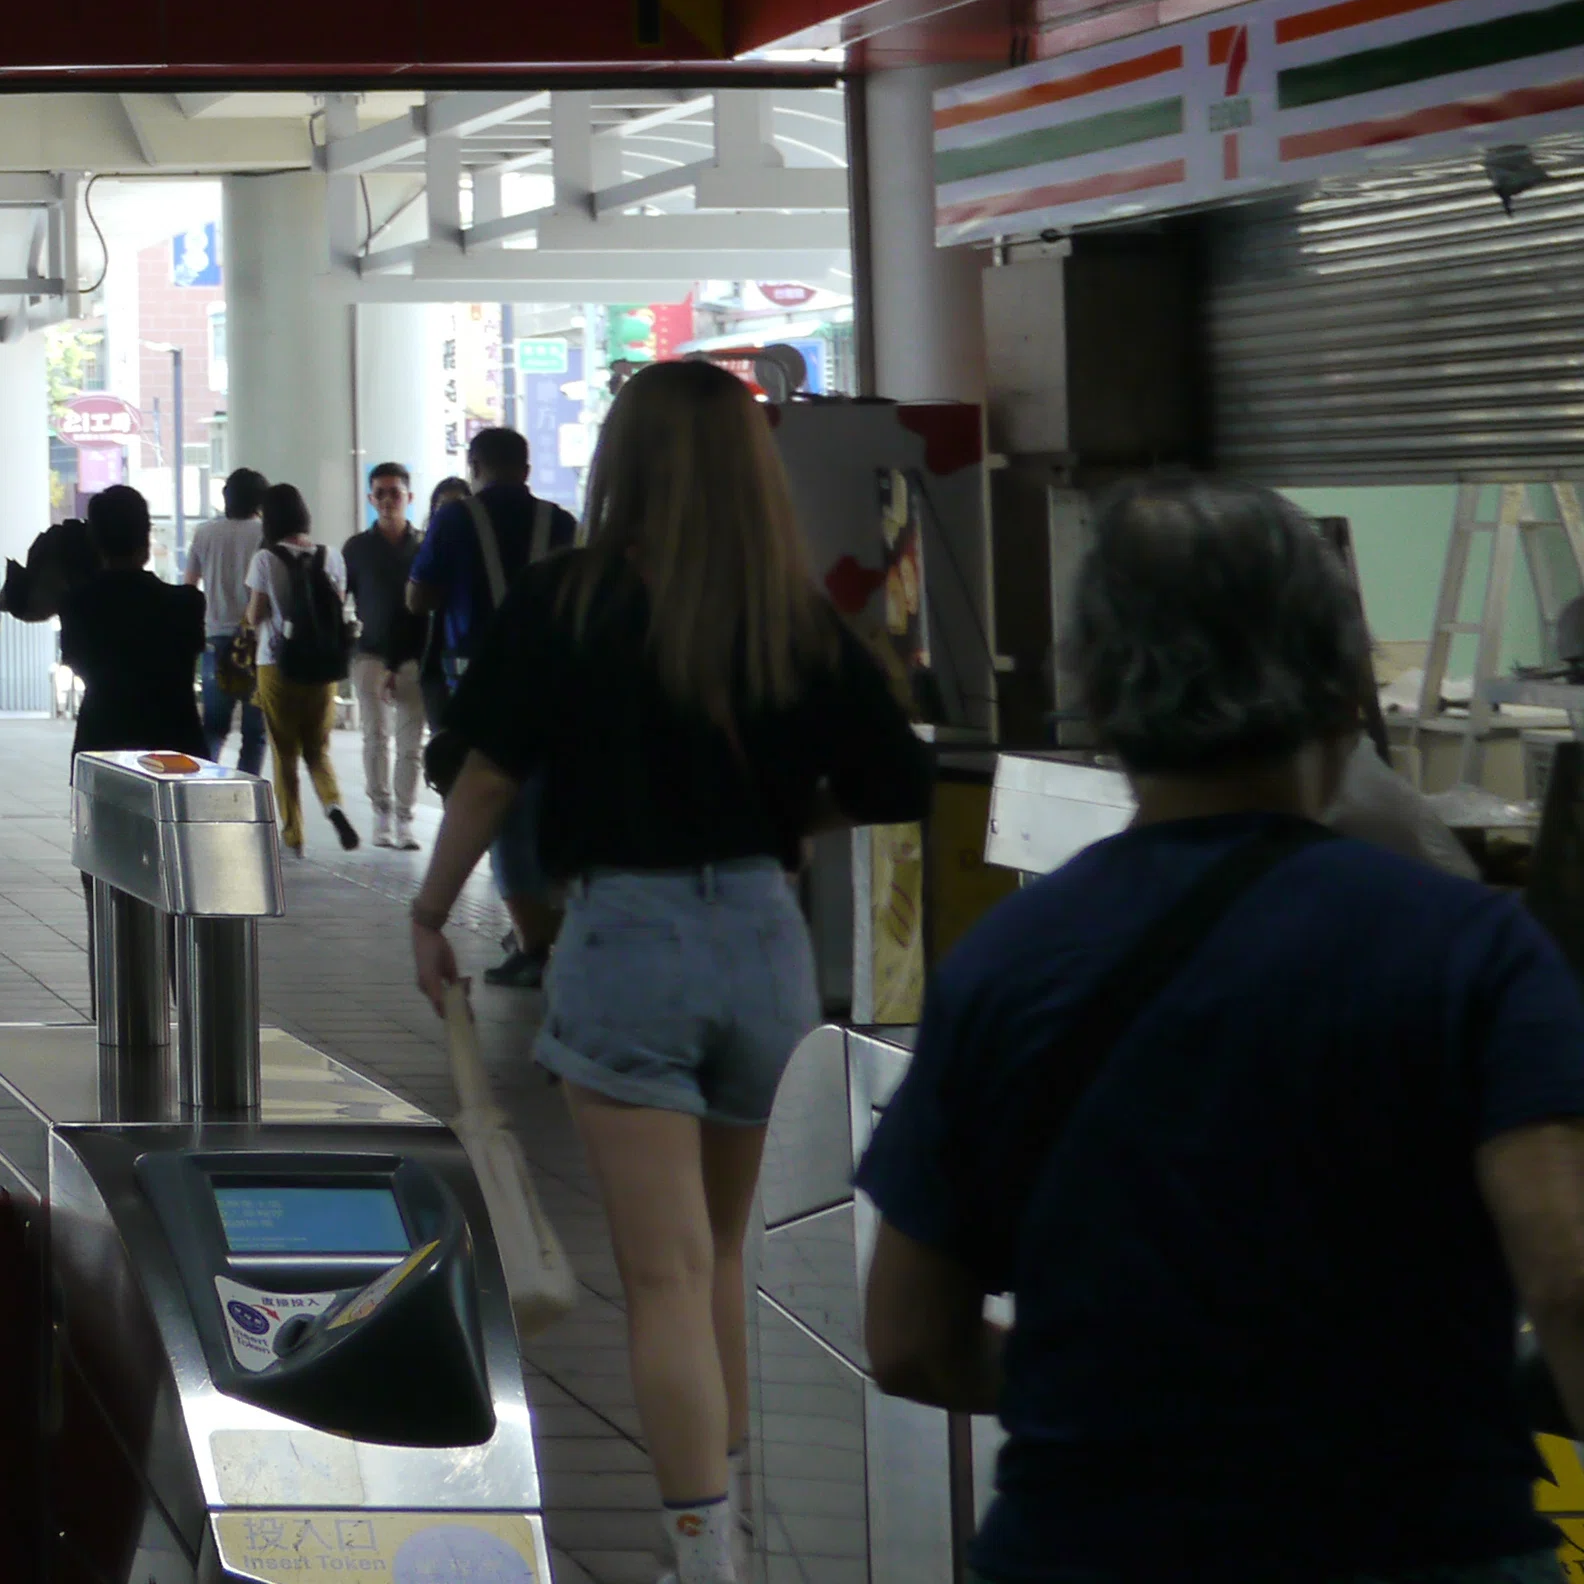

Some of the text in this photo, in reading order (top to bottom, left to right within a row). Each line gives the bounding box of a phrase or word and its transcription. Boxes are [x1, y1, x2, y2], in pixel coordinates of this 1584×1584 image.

[262, 1296, 321, 1308] 直接投入
[243, 1517, 379, 1552] 投入口
[243, 1554, 387, 1572] Insert Token
